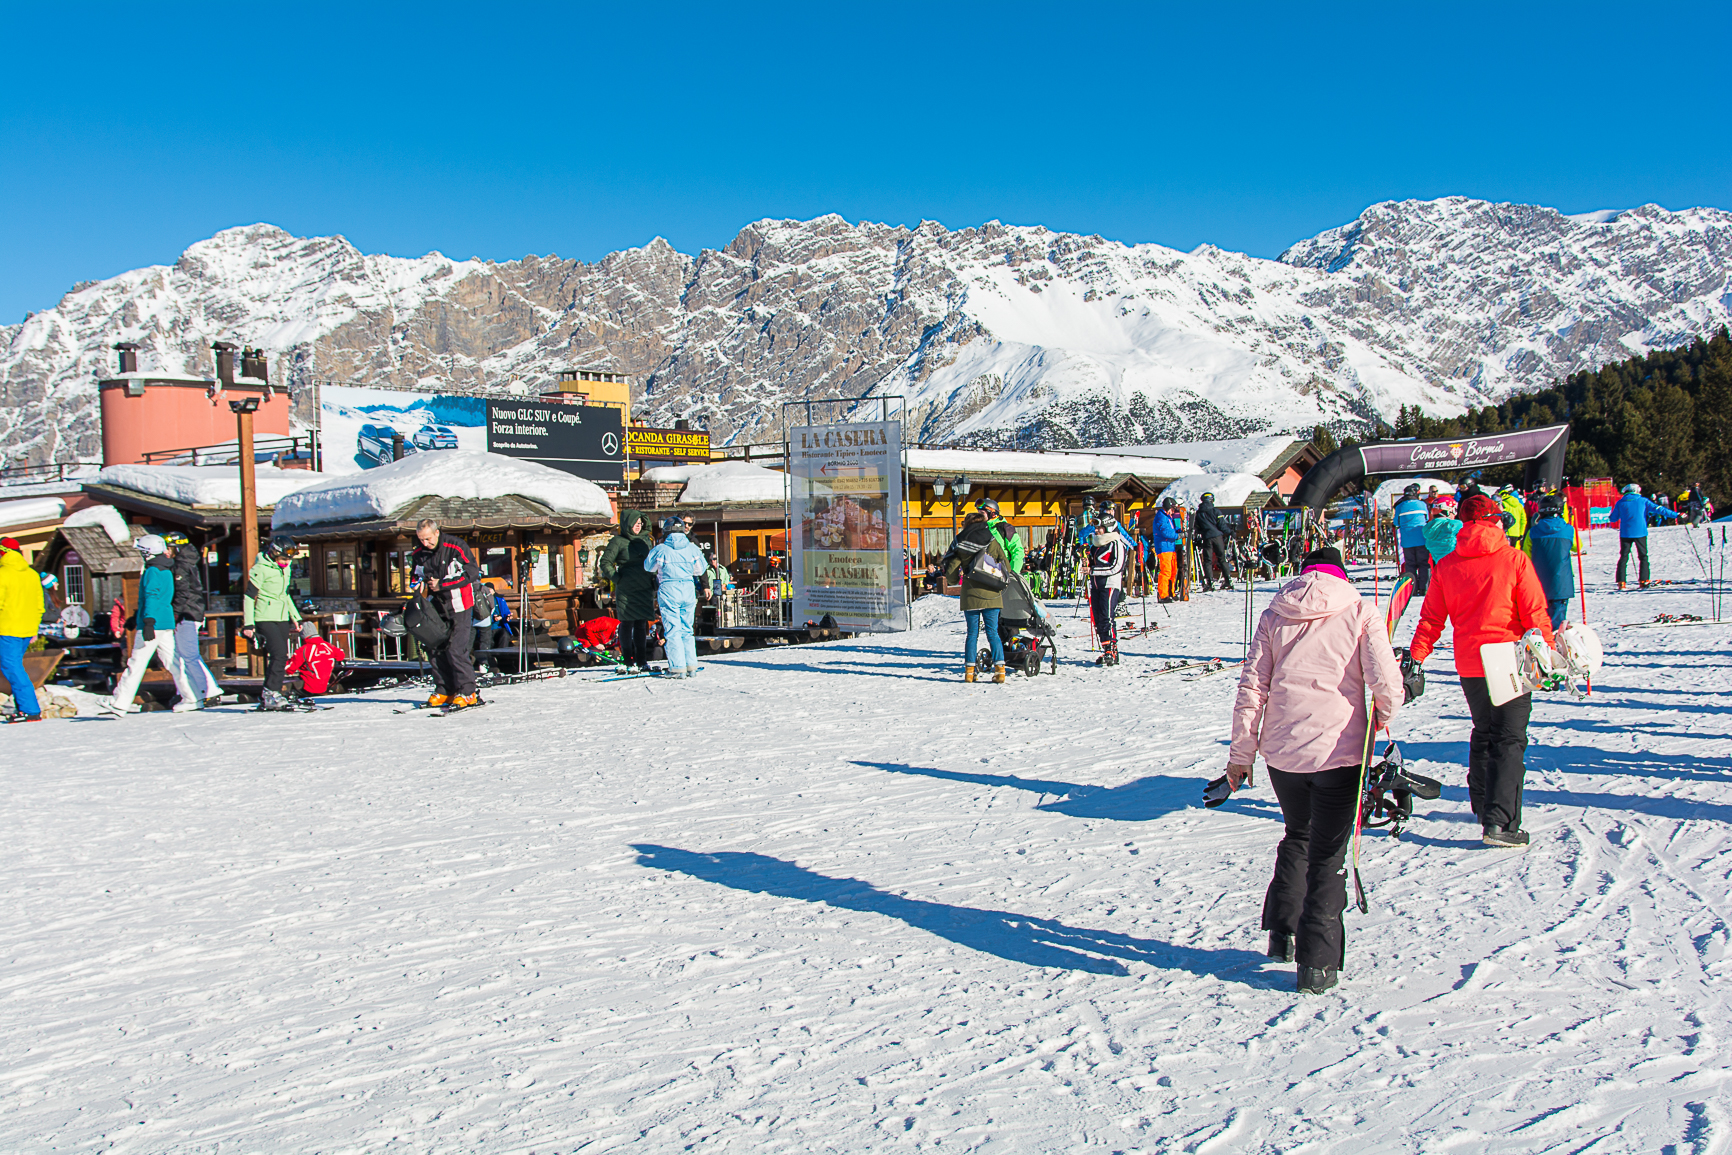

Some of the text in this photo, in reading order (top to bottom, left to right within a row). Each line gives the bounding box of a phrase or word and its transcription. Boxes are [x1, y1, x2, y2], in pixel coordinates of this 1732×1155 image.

[492, 407, 582, 426] Nuovo GLC SUV e Coupé.
[492, 422, 549, 436] Forza interiore.
[666, 433, 710, 446] GIRASOLE
[801, 429, 888, 449] LA CASERA
[635, 446, 671, 456] RISTORANTE
[673, 447, 687, 456] SELF
[687, 448, 710, 457] SERVICE
[802, 449, 887, 459] Ristorante Tipico Enoteca
[1410, 445, 1449, 461] Contea
[1465, 440, 1505, 457] Bormio
[828, 553, 862, 564] Enoteca
[814, 566, 879, 580] LA CASERA
[536, 671, 560, 679] HEAD
